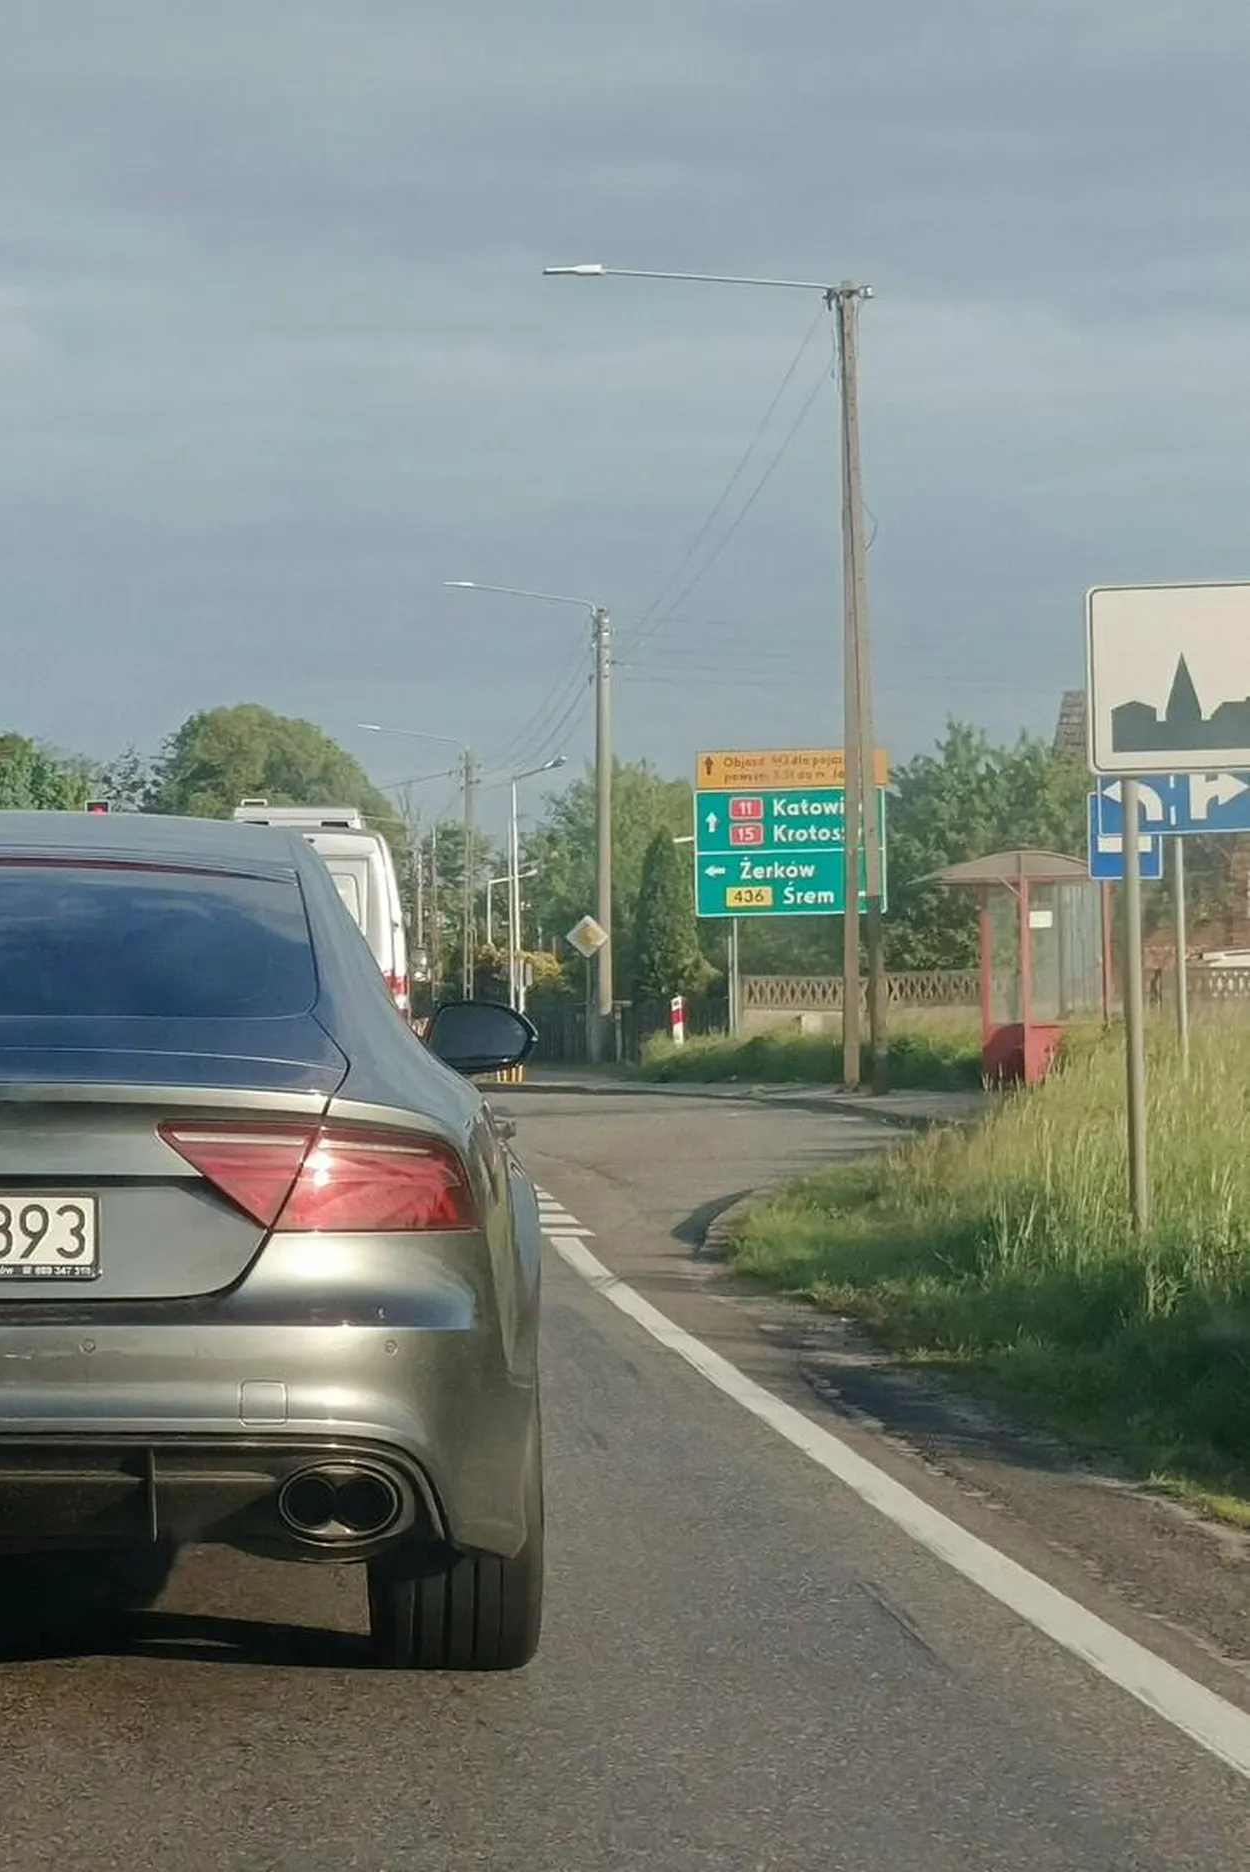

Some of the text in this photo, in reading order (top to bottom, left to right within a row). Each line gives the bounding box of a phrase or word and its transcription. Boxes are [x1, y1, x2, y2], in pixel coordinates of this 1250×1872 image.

[738, 797, 846, 817] 11 Katowi
[738, 824, 845, 843] 15 Krotos
[739, 857, 816, 880] Żerków
[733, 882, 835, 905] 436 Śrem
